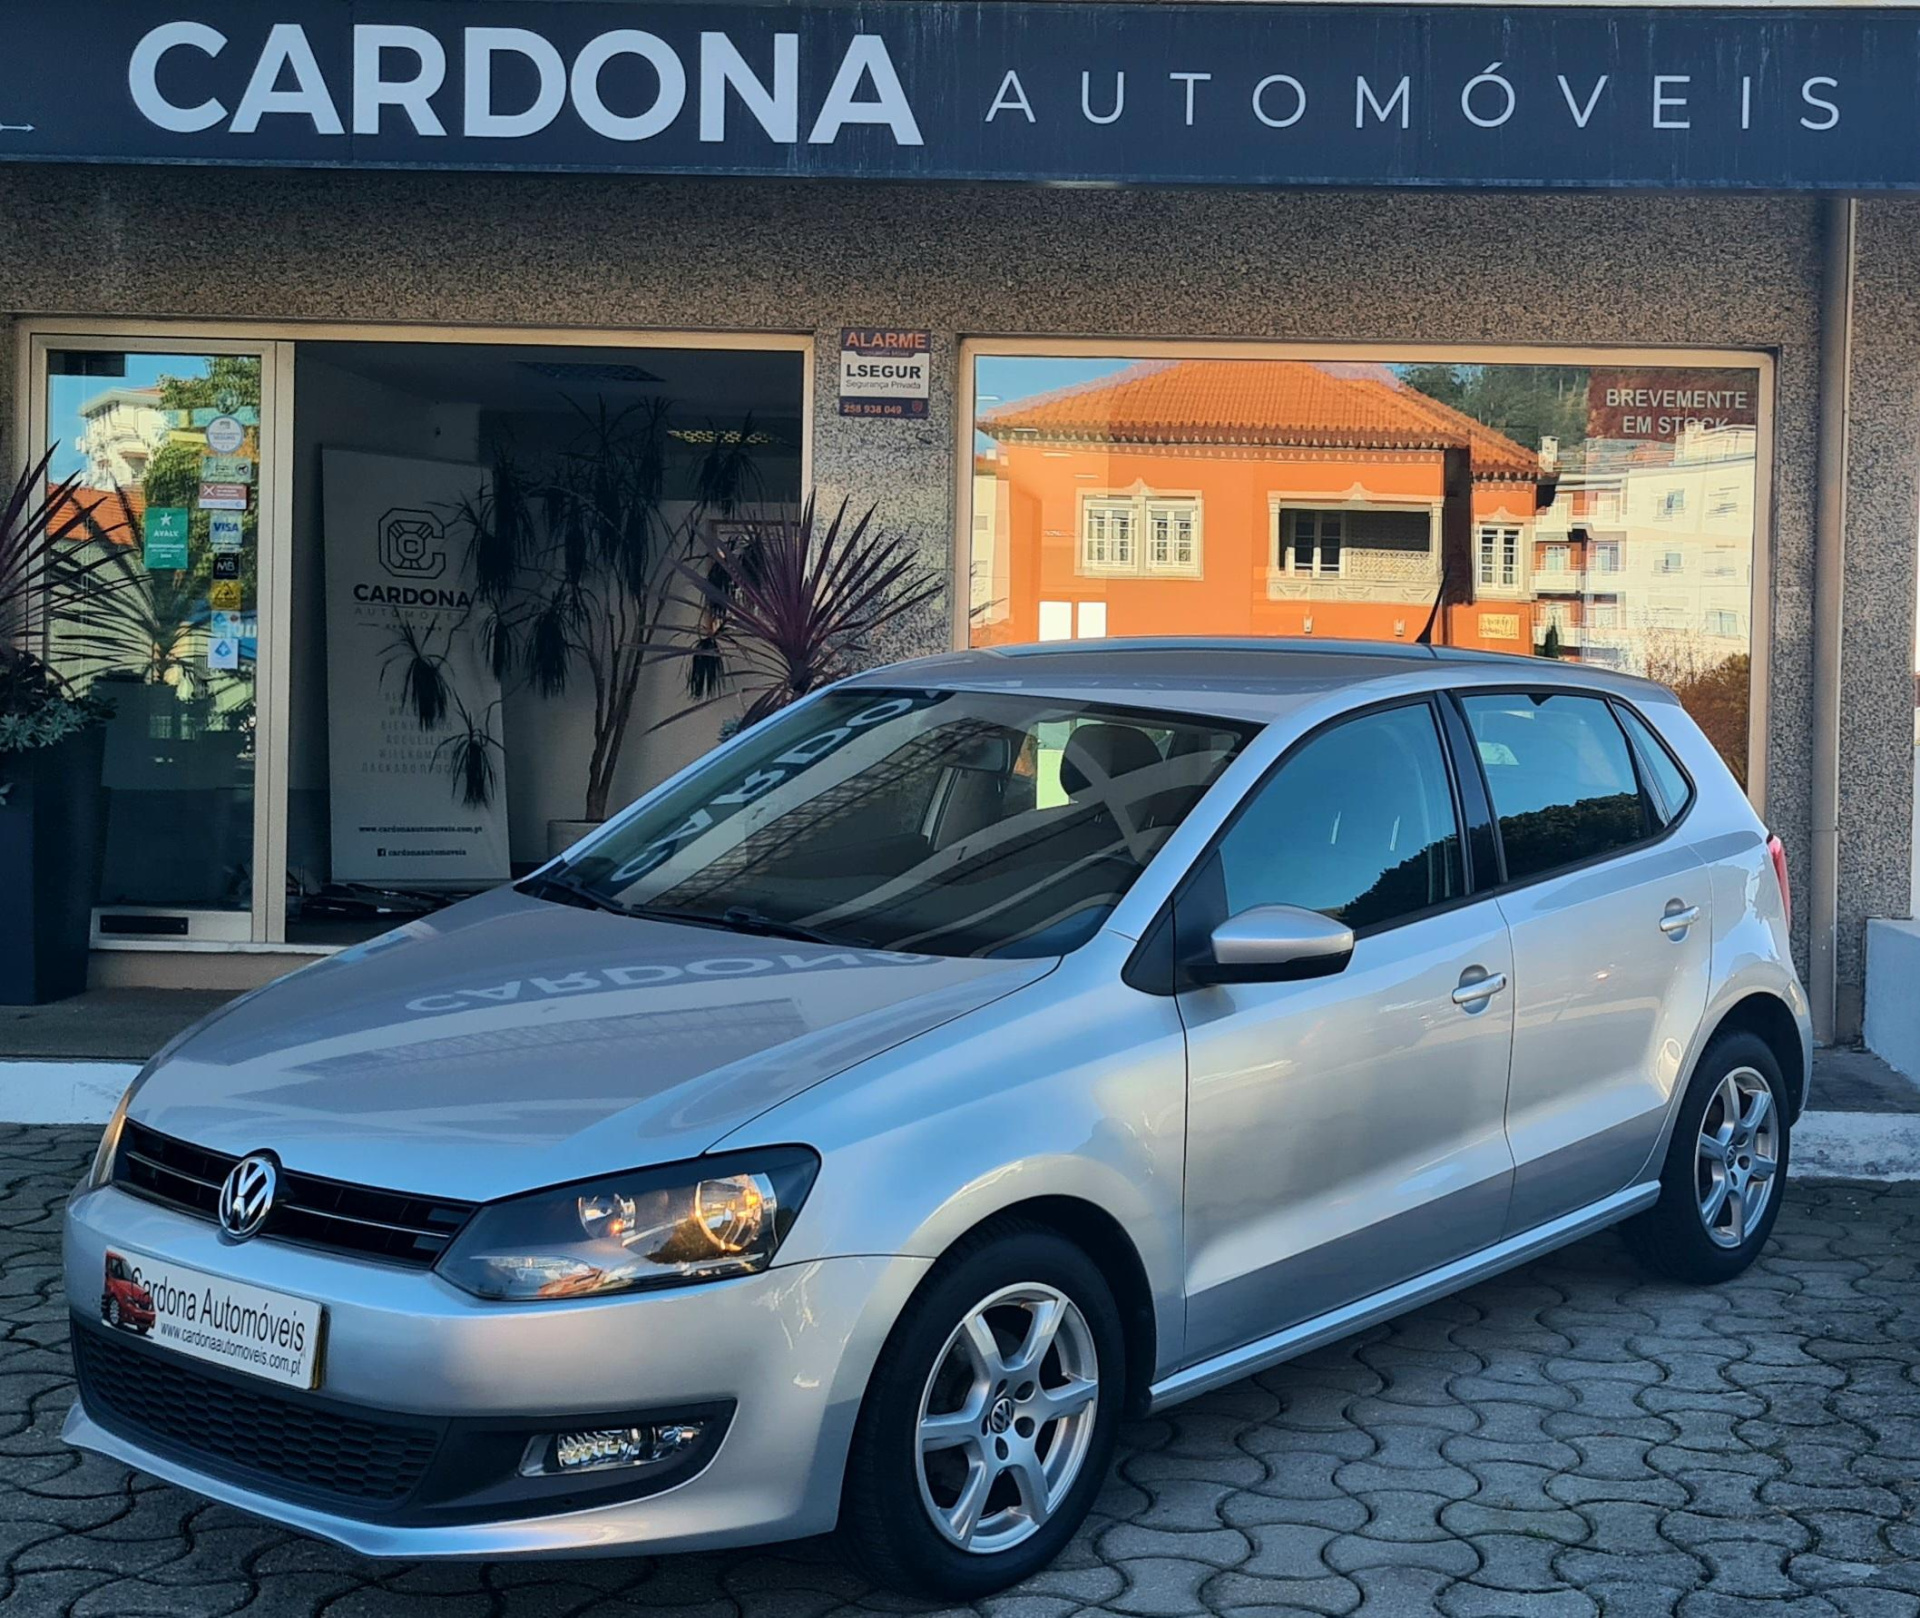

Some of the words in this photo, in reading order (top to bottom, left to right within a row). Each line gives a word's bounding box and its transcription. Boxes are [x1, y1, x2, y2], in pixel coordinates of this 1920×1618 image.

[129, 20, 924, 146] CARDONA
[985, 62, 1841, 131] AUTOMÓVEIS
[846, 332, 926, 348] ALARME
[846, 364, 921, 379] LSEGUR
[846, 379, 889, 390] Segurança
[891, 380, 921, 390] Privada
[1606, 388, 1747, 409] BREVEMENTE
[864, 404, 882, 414] 938
[1623, 416, 1652, 434] EM
[213, 522, 239, 533] VISA
[215, 560, 236, 572] MB
[353, 583, 472, 607] CARDONA
[388, 847, 467, 857] cardonaautomoveis
[200, 1288, 306, 1352] Automóveis
[160, 1320, 301, 1377] www.cardonaautomoveis.com.pt
